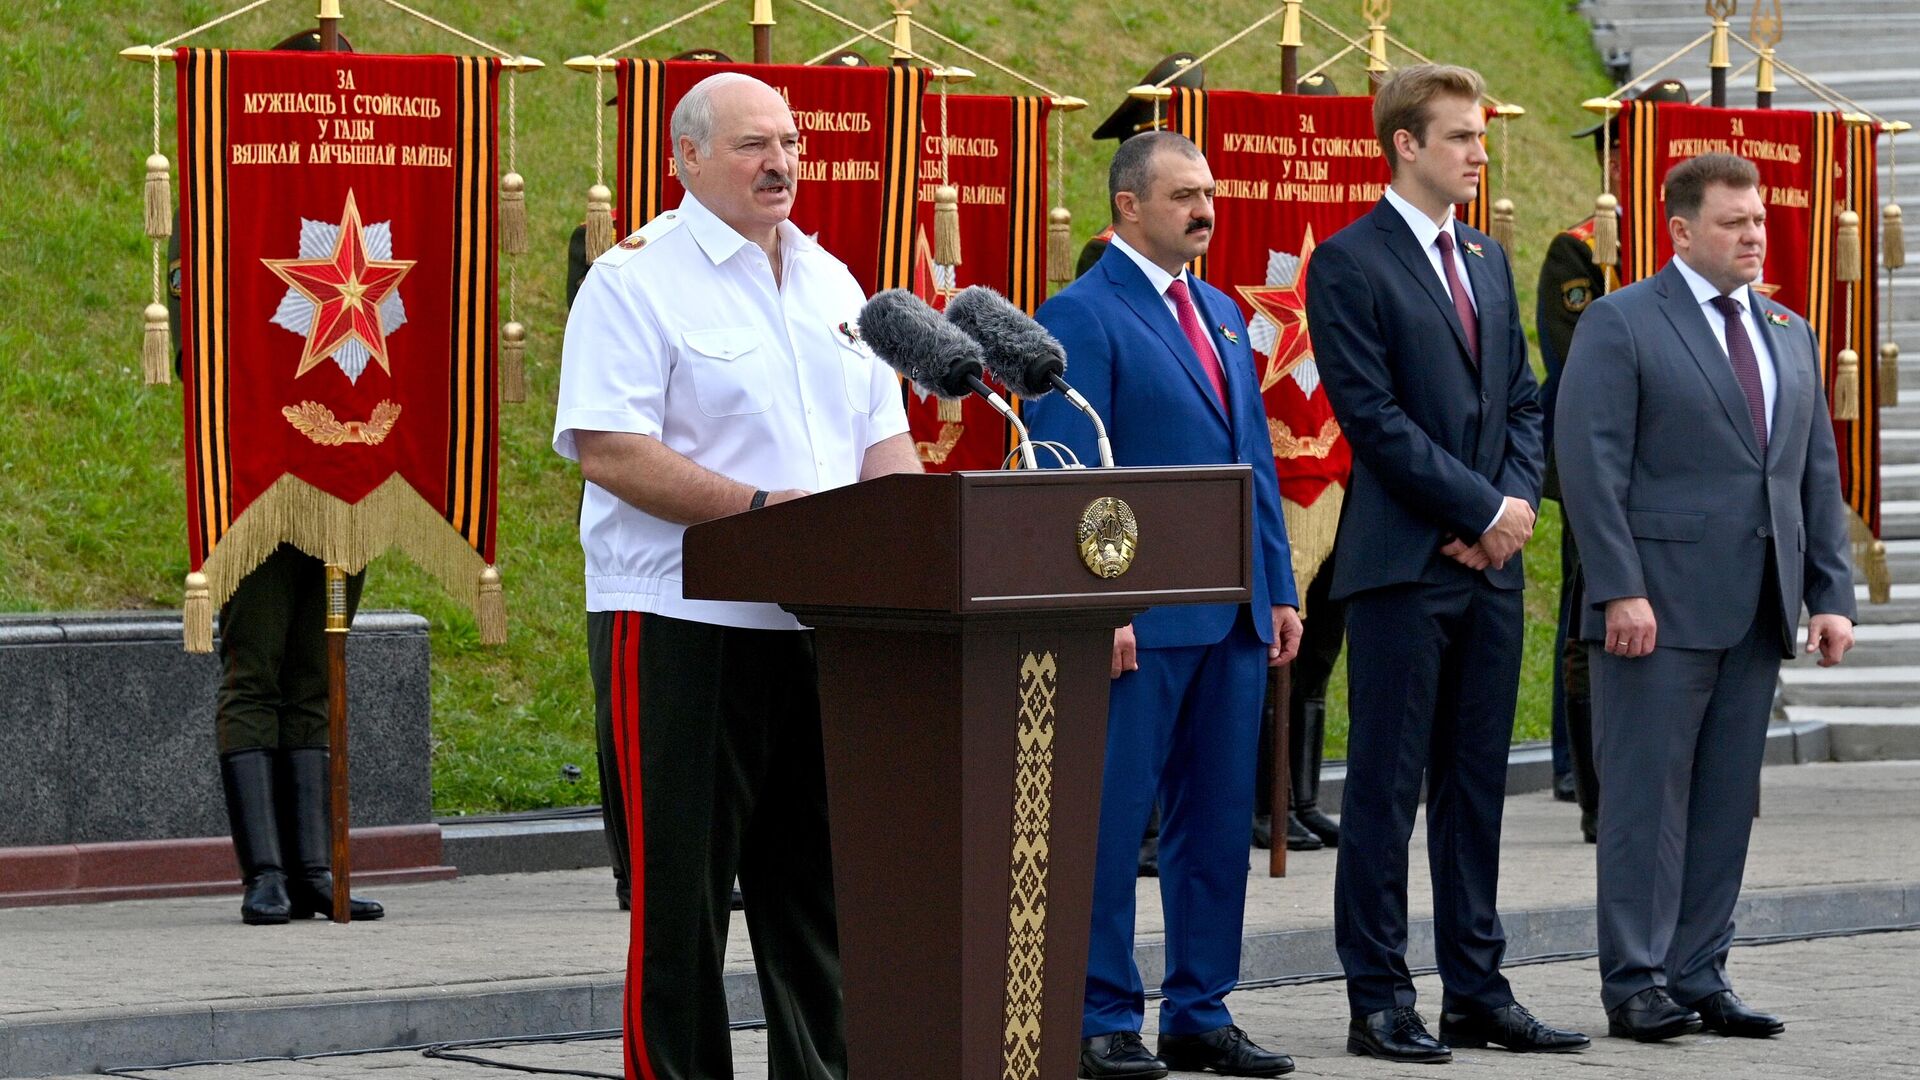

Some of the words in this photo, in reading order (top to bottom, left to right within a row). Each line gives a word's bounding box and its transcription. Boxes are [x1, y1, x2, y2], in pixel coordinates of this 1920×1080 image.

[337, 69, 356, 90] ЗА
[244, 93, 336, 116] МУЖНАСЦЬ
[353, 94, 441, 120] СТОЙКАСЦЬ
[318, 119, 328, 140] У
[333, 119, 375, 143] ГАДЫ
[1299, 114, 1316, 134] ЗА
[1730, 117, 1744, 137] ЗА
[232, 141, 300, 165] ВЯЛІКАЙ
[308, 141, 396, 166] АЙЧЫННАЙ
[401, 144, 453, 168] ВАЙНЫ
[1223, 133, 1297, 158] МУЖНАСЦЬ
[1312, 136, 1382, 160] СТОЙКАСЦЬ
[1741, 139, 1801, 165] СТОЙКАСЦЬ
[832, 158, 880, 181] ВАЙНЫ
[1282, 160, 1292, 179] У
[1295, 160, 1328, 183] ГАДЫ
[962, 184, 1006, 205] ВАЙНЫ
[1215, 178, 1269, 200] ВЯЛІКАЙ
[1274, 180, 1344, 203] АЙЧЫННАЙ
[1770, 186, 1809, 209] ВАЙНЫ
